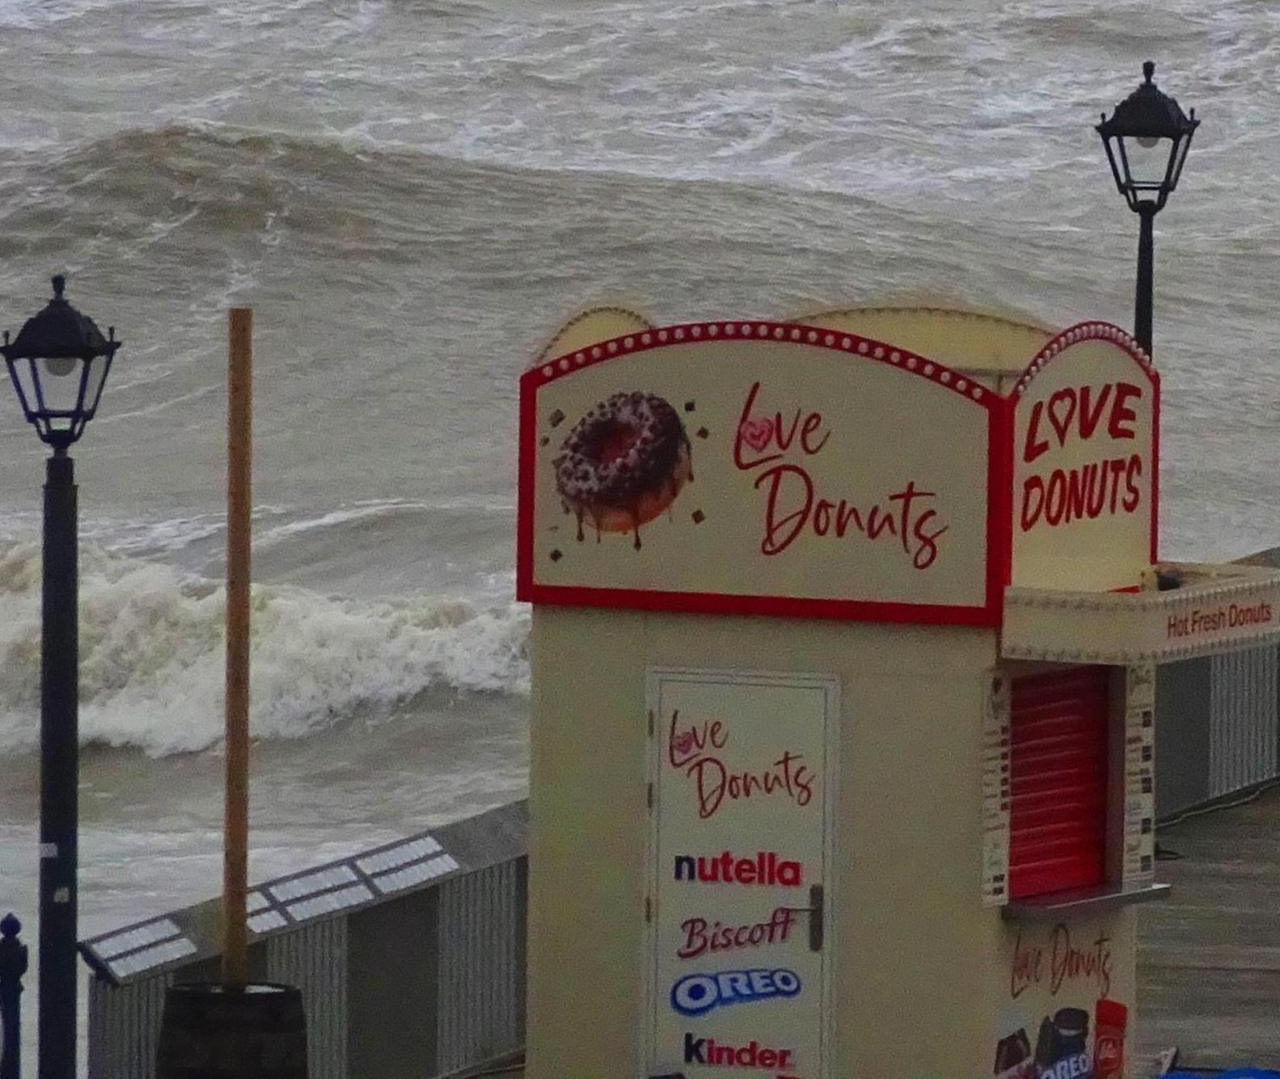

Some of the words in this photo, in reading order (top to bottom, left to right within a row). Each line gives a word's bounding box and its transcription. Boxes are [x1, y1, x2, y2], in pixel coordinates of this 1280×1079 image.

[735, 381, 831, 470] Love
[1023, 382, 1142, 463] LOVE
[754, 463, 949, 570] Donuts
[1020, 453, 1142, 532] DONUTS
[1167, 614, 1189, 639] Hot
[1190, 609, 1226, 632] Fresh
[1229, 602, 1273, 628] Donuts
[669, 708, 729, 768] Love
[687, 750, 816, 819] Donuts
[674, 851, 802, 887] nutella
[677, 906, 796, 960] Biscoff
[1051, 922, 1112, 999] Donuts
[672, 969, 801, 1015] OREO
